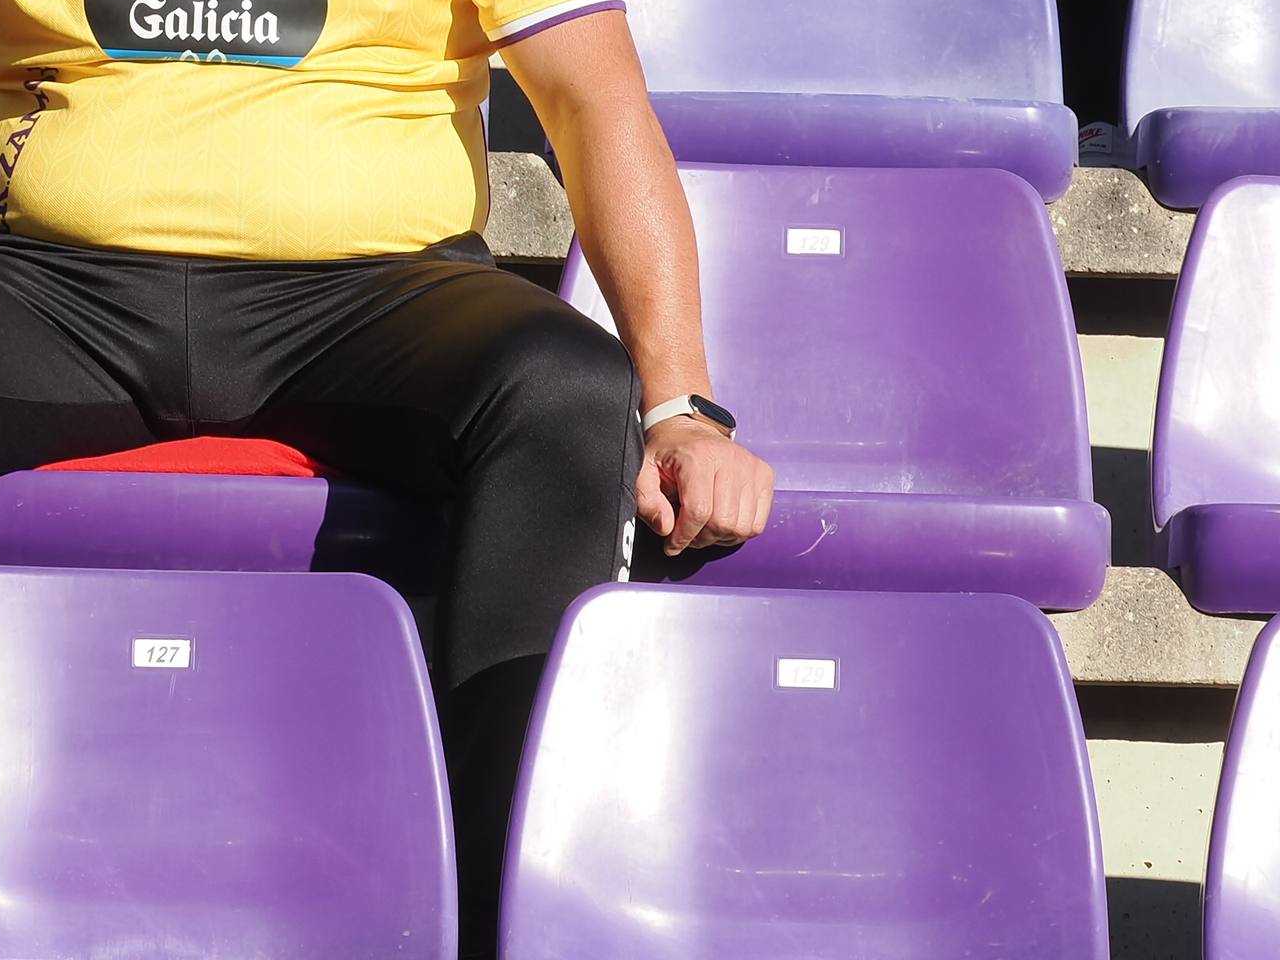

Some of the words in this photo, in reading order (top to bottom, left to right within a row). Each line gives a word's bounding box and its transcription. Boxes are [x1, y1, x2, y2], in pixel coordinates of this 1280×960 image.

[799, 234, 831, 252] 129
[146, 646, 180, 664] 127
[791, 665, 826, 684] 129
